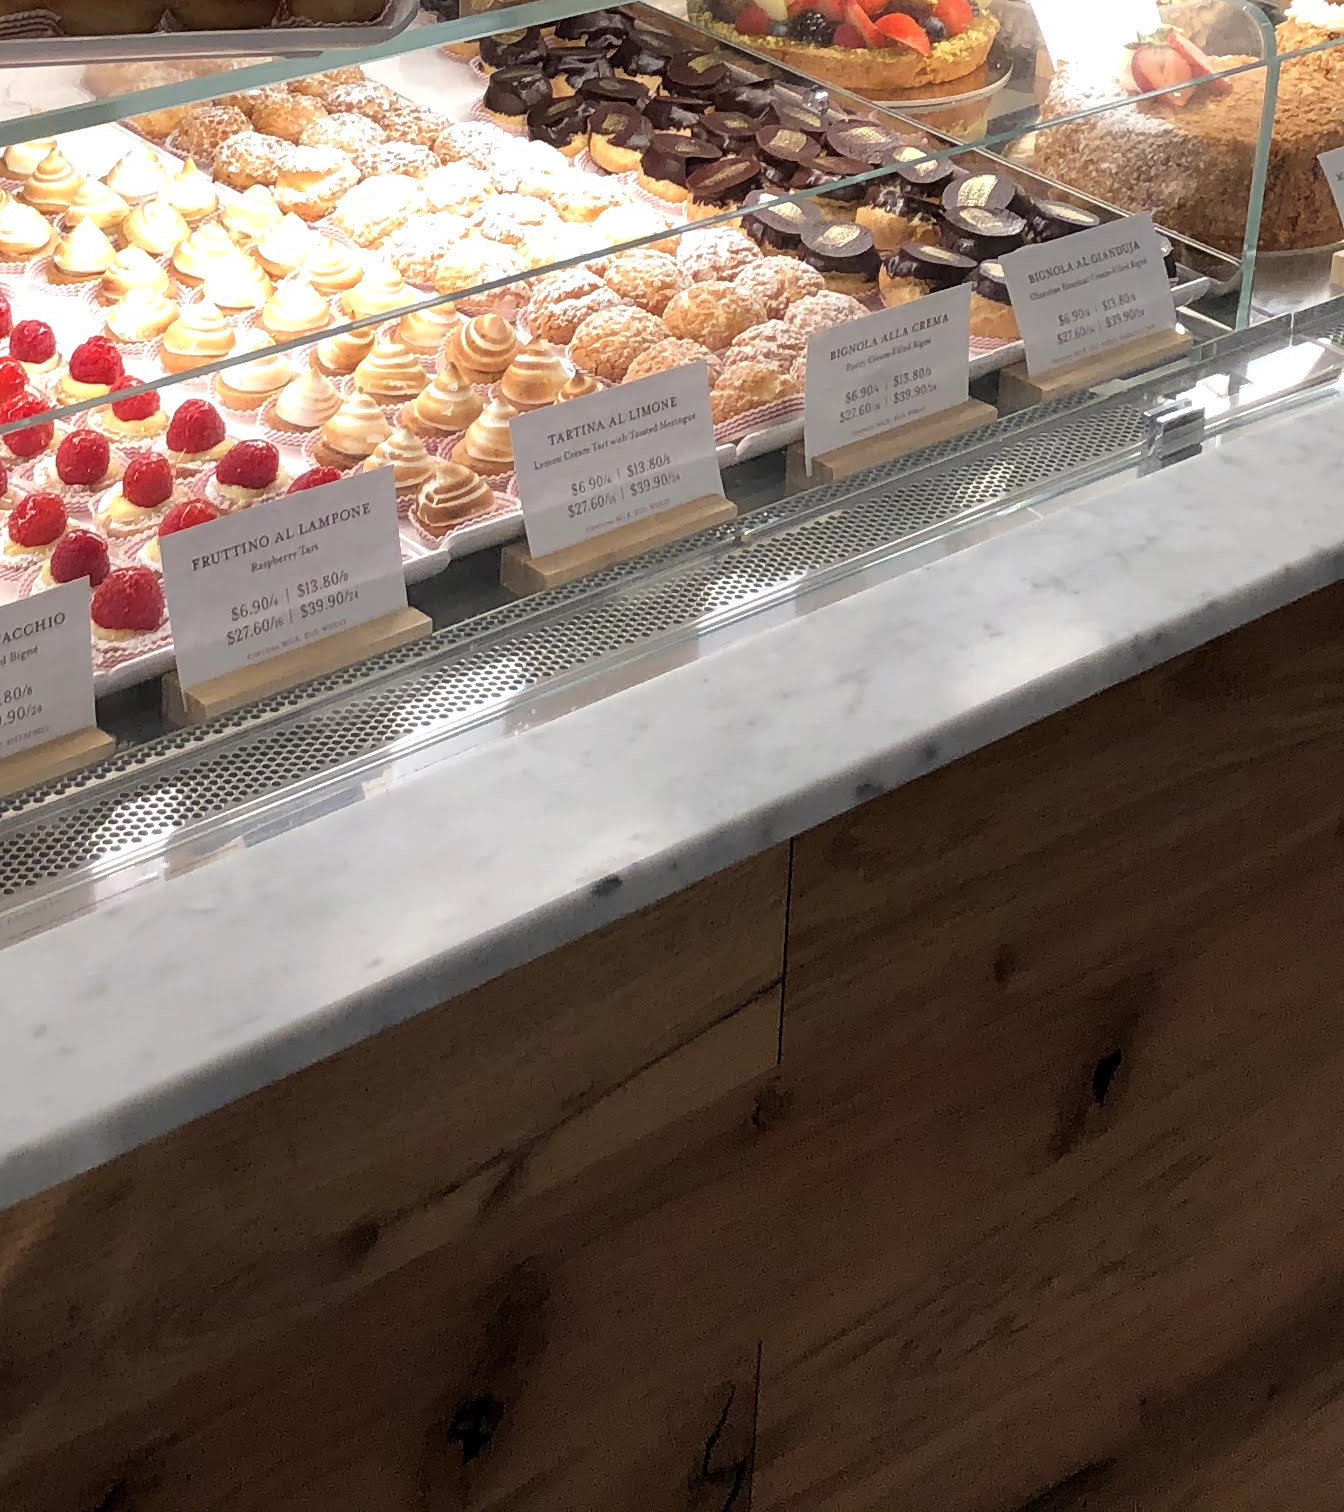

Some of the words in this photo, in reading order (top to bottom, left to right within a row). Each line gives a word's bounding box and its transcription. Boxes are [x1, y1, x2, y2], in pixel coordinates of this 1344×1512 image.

[1027, 261, 1074, 285] BIGNOLA
[1076, 256, 1090, 270] AL
[1091, 240, 1141, 264] GIANDUJA
[830, 338, 878, 361] BIGNOLA
[880, 326, 909, 344] ALLA
[911, 313, 949, 333] CREMA
[547, 419, 605, 447] TARTINA
[608, 412, 626, 428] AL
[628, 396, 678, 422] LIMONE
[534, 457, 563, 471] Lemon
[563, 446, 590, 461] Cream
[592, 440, 608, 453] Tart
[630, 424, 658, 440] Toasted
[191, 535, 270, 572] FRUTTINO
[274, 526, 295, 544] AL
[298, 502, 371, 535] LAMPONE
[250, 550, 297, 573] Raspberry
[298, 542, 319, 557] Tart
[230, 593, 279, 622] $6.90/4
[296, 569, 349, 599] $13.80/8
